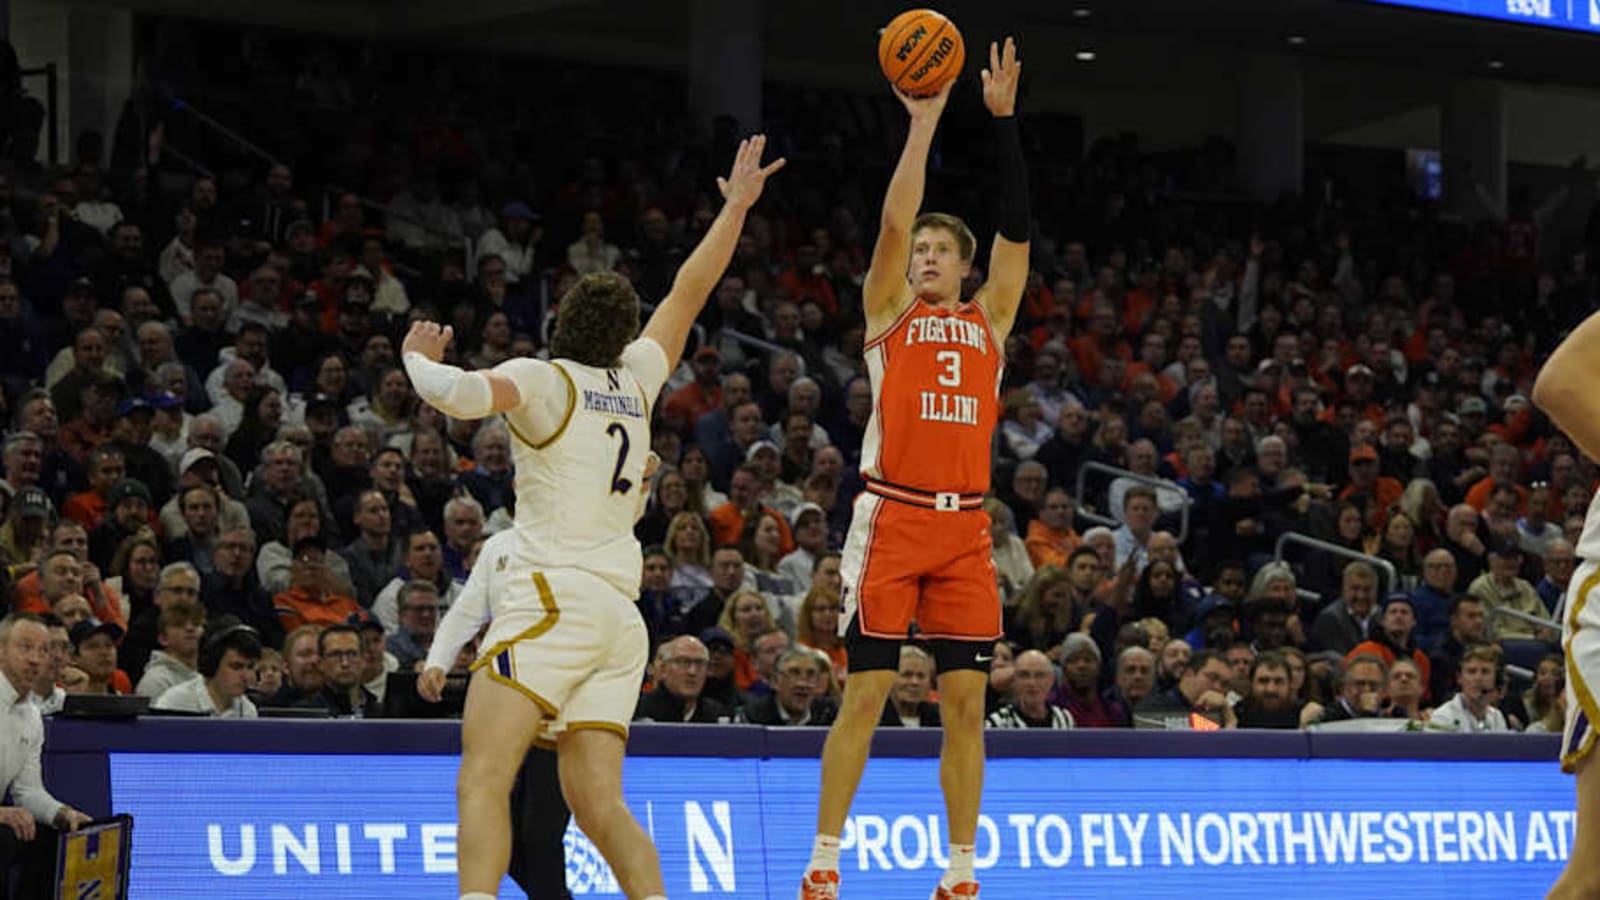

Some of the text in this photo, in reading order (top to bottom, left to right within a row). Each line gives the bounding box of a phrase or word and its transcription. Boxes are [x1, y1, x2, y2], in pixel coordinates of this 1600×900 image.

[905, 315, 987, 355] FIGHTING
[936, 350, 961, 387] 3
[920, 391, 978, 425] ILLINI
[606, 422, 632, 496] 2
[684, 800, 737, 893] N
[1008, 814, 1073, 868] TO
[1080, 813, 1149, 867] FLY
[1158, 811, 1518, 866] NORTHWESTERN
[1524, 811, 1578, 862] AT
